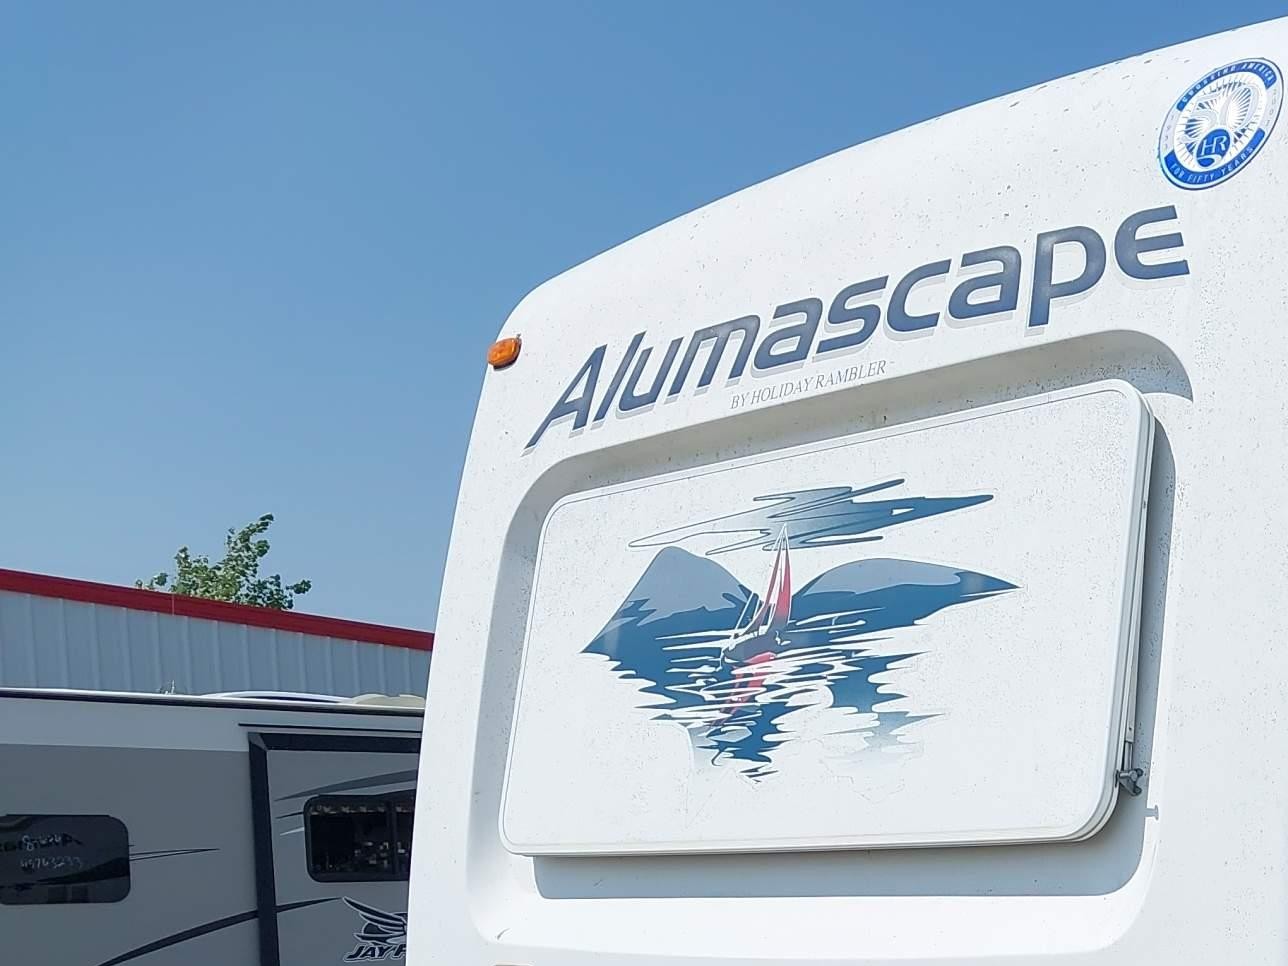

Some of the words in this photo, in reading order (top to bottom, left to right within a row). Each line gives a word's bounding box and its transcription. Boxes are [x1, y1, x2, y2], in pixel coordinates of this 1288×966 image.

[1169, 162, 1185, 179] FOR
[1187, 173, 1216, 184] FIFTY
[1220, 146, 1255, 176] YEARS
[525, 203, 1191, 449] Alumascape
[730, 392, 750, 410] BY
[750, 376, 814, 405] HOLIDAY
[814, 359, 887, 390] RAMBLER
[344, 944, 393, 961] JAY
